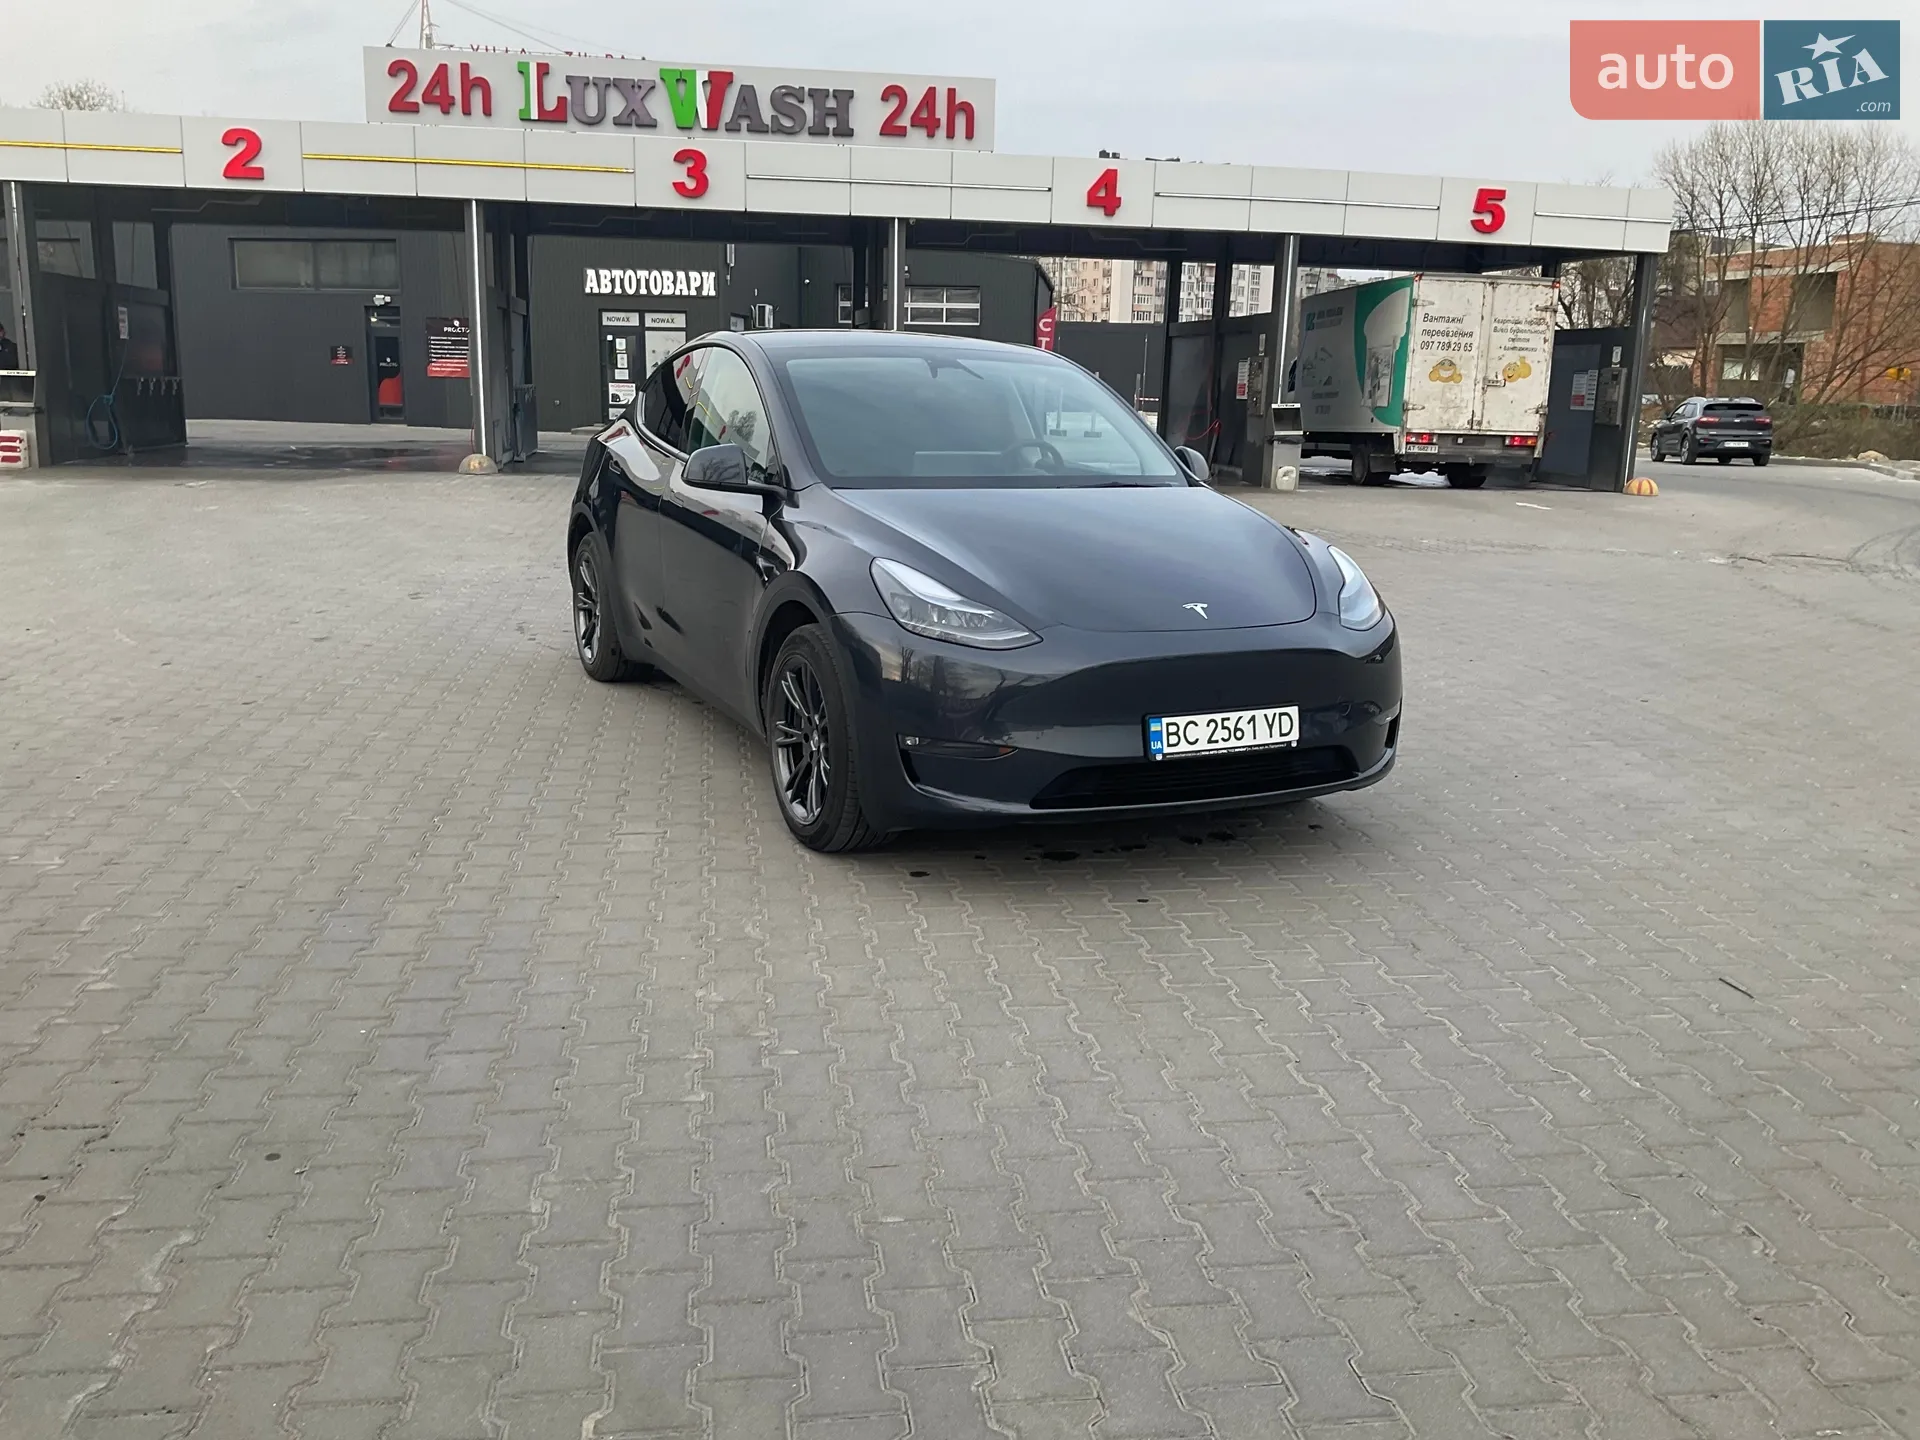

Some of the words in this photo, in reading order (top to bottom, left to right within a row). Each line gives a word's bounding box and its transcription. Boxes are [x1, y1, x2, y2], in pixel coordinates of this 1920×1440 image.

[387, 59, 492, 116] 24h
[879, 84, 975, 140] 24h
[221, 128, 264, 180] 2
[672, 148, 709, 199] 3
[1086, 168, 1122, 217] 4
[1470, 188, 1507, 234] 5
[584, 268, 717, 296] АВТОТОВАРИ
[606, 315, 631, 323] NOWAX
[1421, 328, 1474, 339] перевезення
[1422, 312, 1465, 324] Вантажні
[1420, 340, 1435, 350] 097
[1436, 341, 1451, 351] 789
[1452, 341, 1462, 352] 29
[1463, 342, 1473, 352] 65
[1151, 741, 1163, 750] UA
[1165, 720, 1200, 748] BC
[1206, 714, 1257, 744] 2561
[1263, 711, 1294, 739] YD
